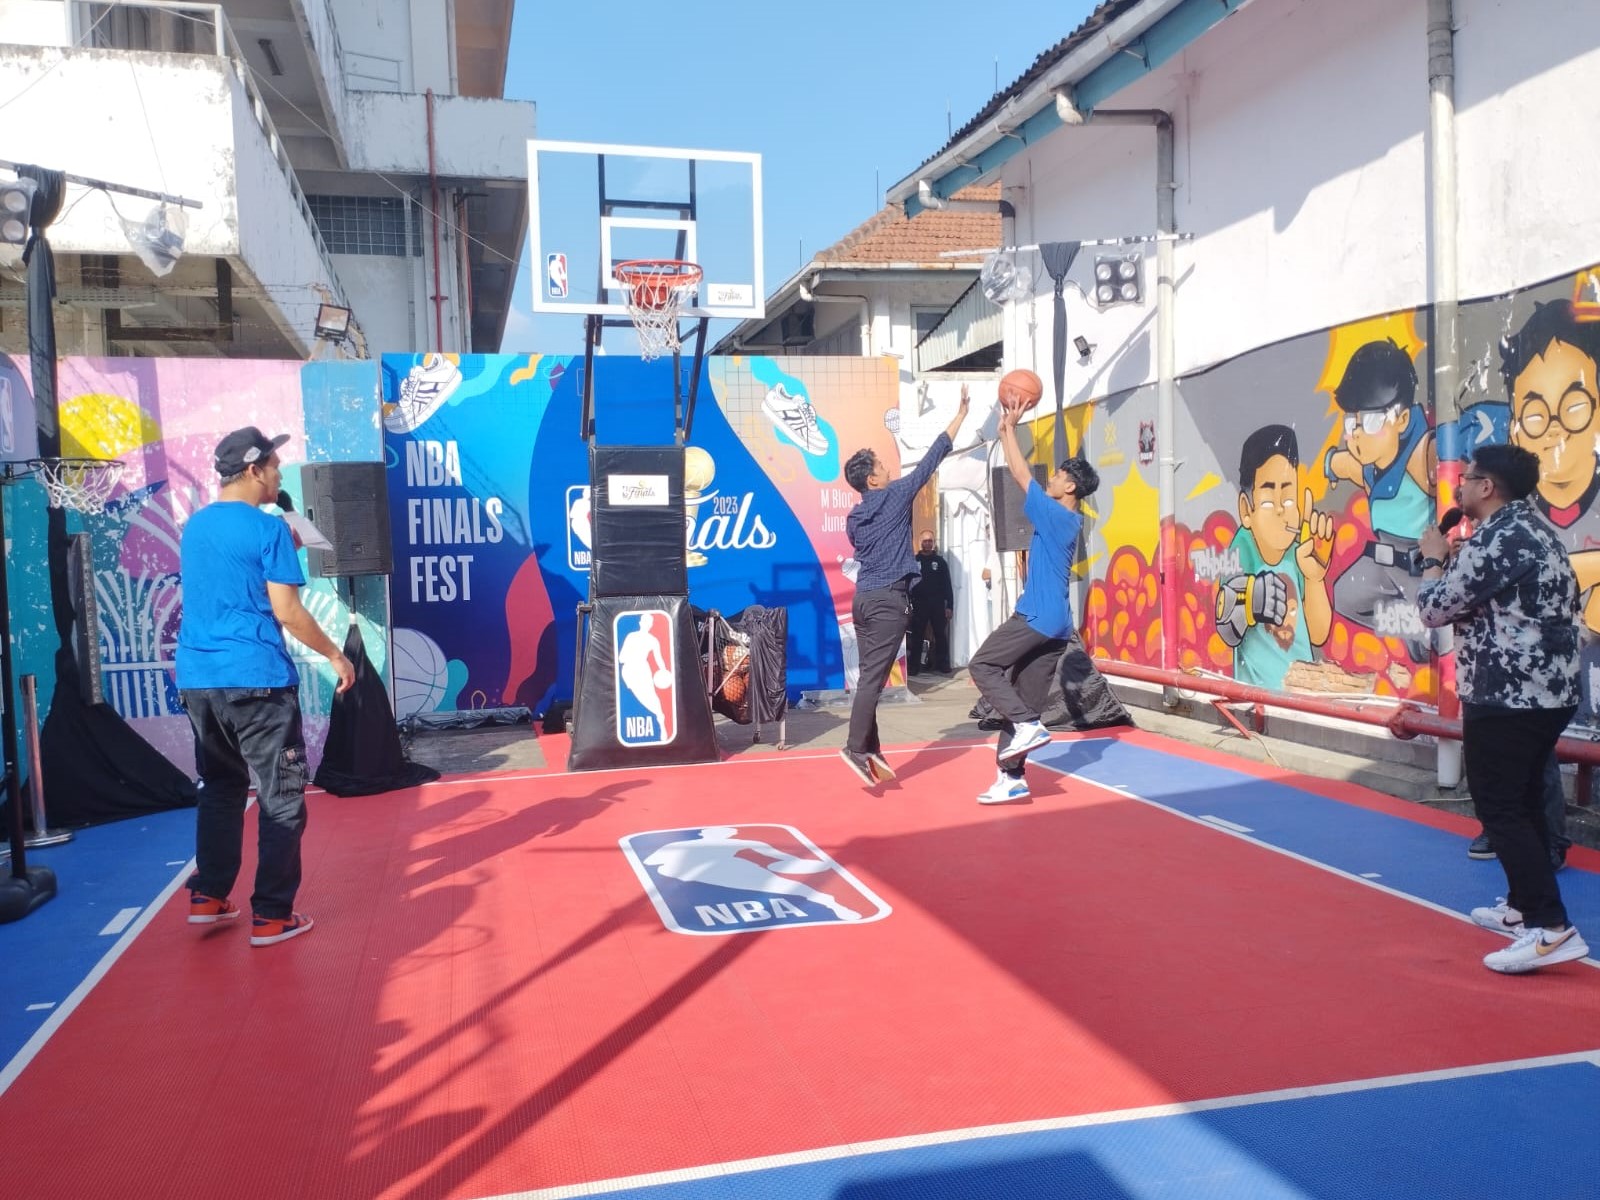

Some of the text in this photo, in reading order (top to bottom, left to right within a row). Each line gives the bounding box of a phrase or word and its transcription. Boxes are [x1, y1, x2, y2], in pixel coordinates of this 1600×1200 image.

[405, 439, 463, 487] NBA
[713, 496, 738, 515] 2023
[820, 489, 854, 509] M Bloc
[408, 497, 504, 545] FINALS
[821, 512, 847, 532] June
[574, 551, 591, 565] NBA
[409, 555, 474, 603] FEST
[625, 715, 655, 738] NBA
[694, 897, 809, 927] NBA
